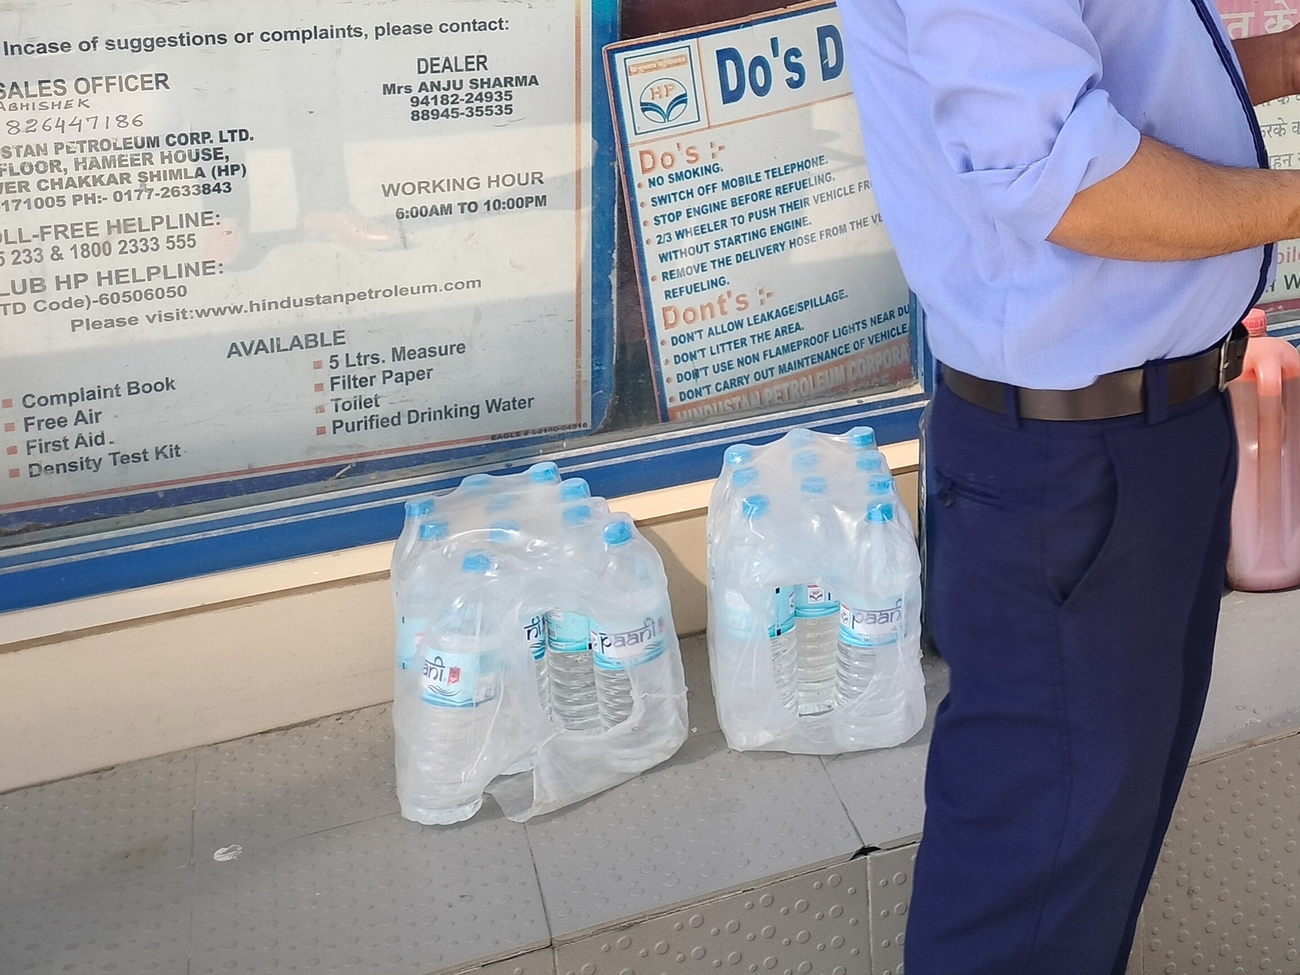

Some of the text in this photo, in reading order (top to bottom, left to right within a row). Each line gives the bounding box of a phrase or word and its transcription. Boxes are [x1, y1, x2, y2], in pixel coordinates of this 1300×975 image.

[3, 17, 509, 57] Incase of suggestions or complaints, please contact:
[416, 54, 489, 75] DEALER
[715, 36, 807, 106] Do's
[74, 73, 170, 96] OFFICER
[382, 74, 540, 96] Mrs ANJU SHARMA
[409, 90, 513, 108] 94182-24935
[410, 104, 513, 122] 88945-35535
[54, 129, 254, 156] PETROLEUM CORP. LTD.
[74, 147, 229, 172] HAMEER HOUSE,
[638, 142, 701, 175] Do's
[36, 163, 247, 192] CHAKKAR SHIMLA (HP)
[381, 171, 545, 198] WORKING HOUR
[648, 162, 725, 189] NO SMOKING.
[650, 155, 829, 208] SWITCH OFF MOBILE TELEPHONE.
[112, 181, 232, 203] 0177-2633843
[653, 171, 836, 227] STOP ENGINE BEFORE REFUELING.
[395, 195, 548, 219] 6:00AM TO 10:00PM
[106, 210, 221, 235] HELPLINE:
[70, 233, 197, 261] 1800 2333 555
[55, 260, 224, 291] HP HELPLINE:
[33, 284, 188, 312] Code)-60506050
[661, 290, 750, 330] Dont's
[70, 313, 139, 333] Please
[670, 330, 704, 347] DON'T
[707, 319, 744, 338] ALLOW
[227, 330, 346, 358] AVAILABLE
[328, 341, 467, 369] 5 Ltrs. Measure
[673, 323, 805, 366] DON'T LITTER THE AREA.
[330, 365, 434, 391] Filter Paper
[22, 377, 176, 409] Complaint Book
[330, 394, 380, 413] Toilet
[24, 409, 103, 432] Free Air
[332, 394, 535, 435] Purified Drinking Water
[26, 431, 105, 455] First Aid
[28, 443, 181, 478] Density Test Kit
[599, 617, 657, 654] paani
